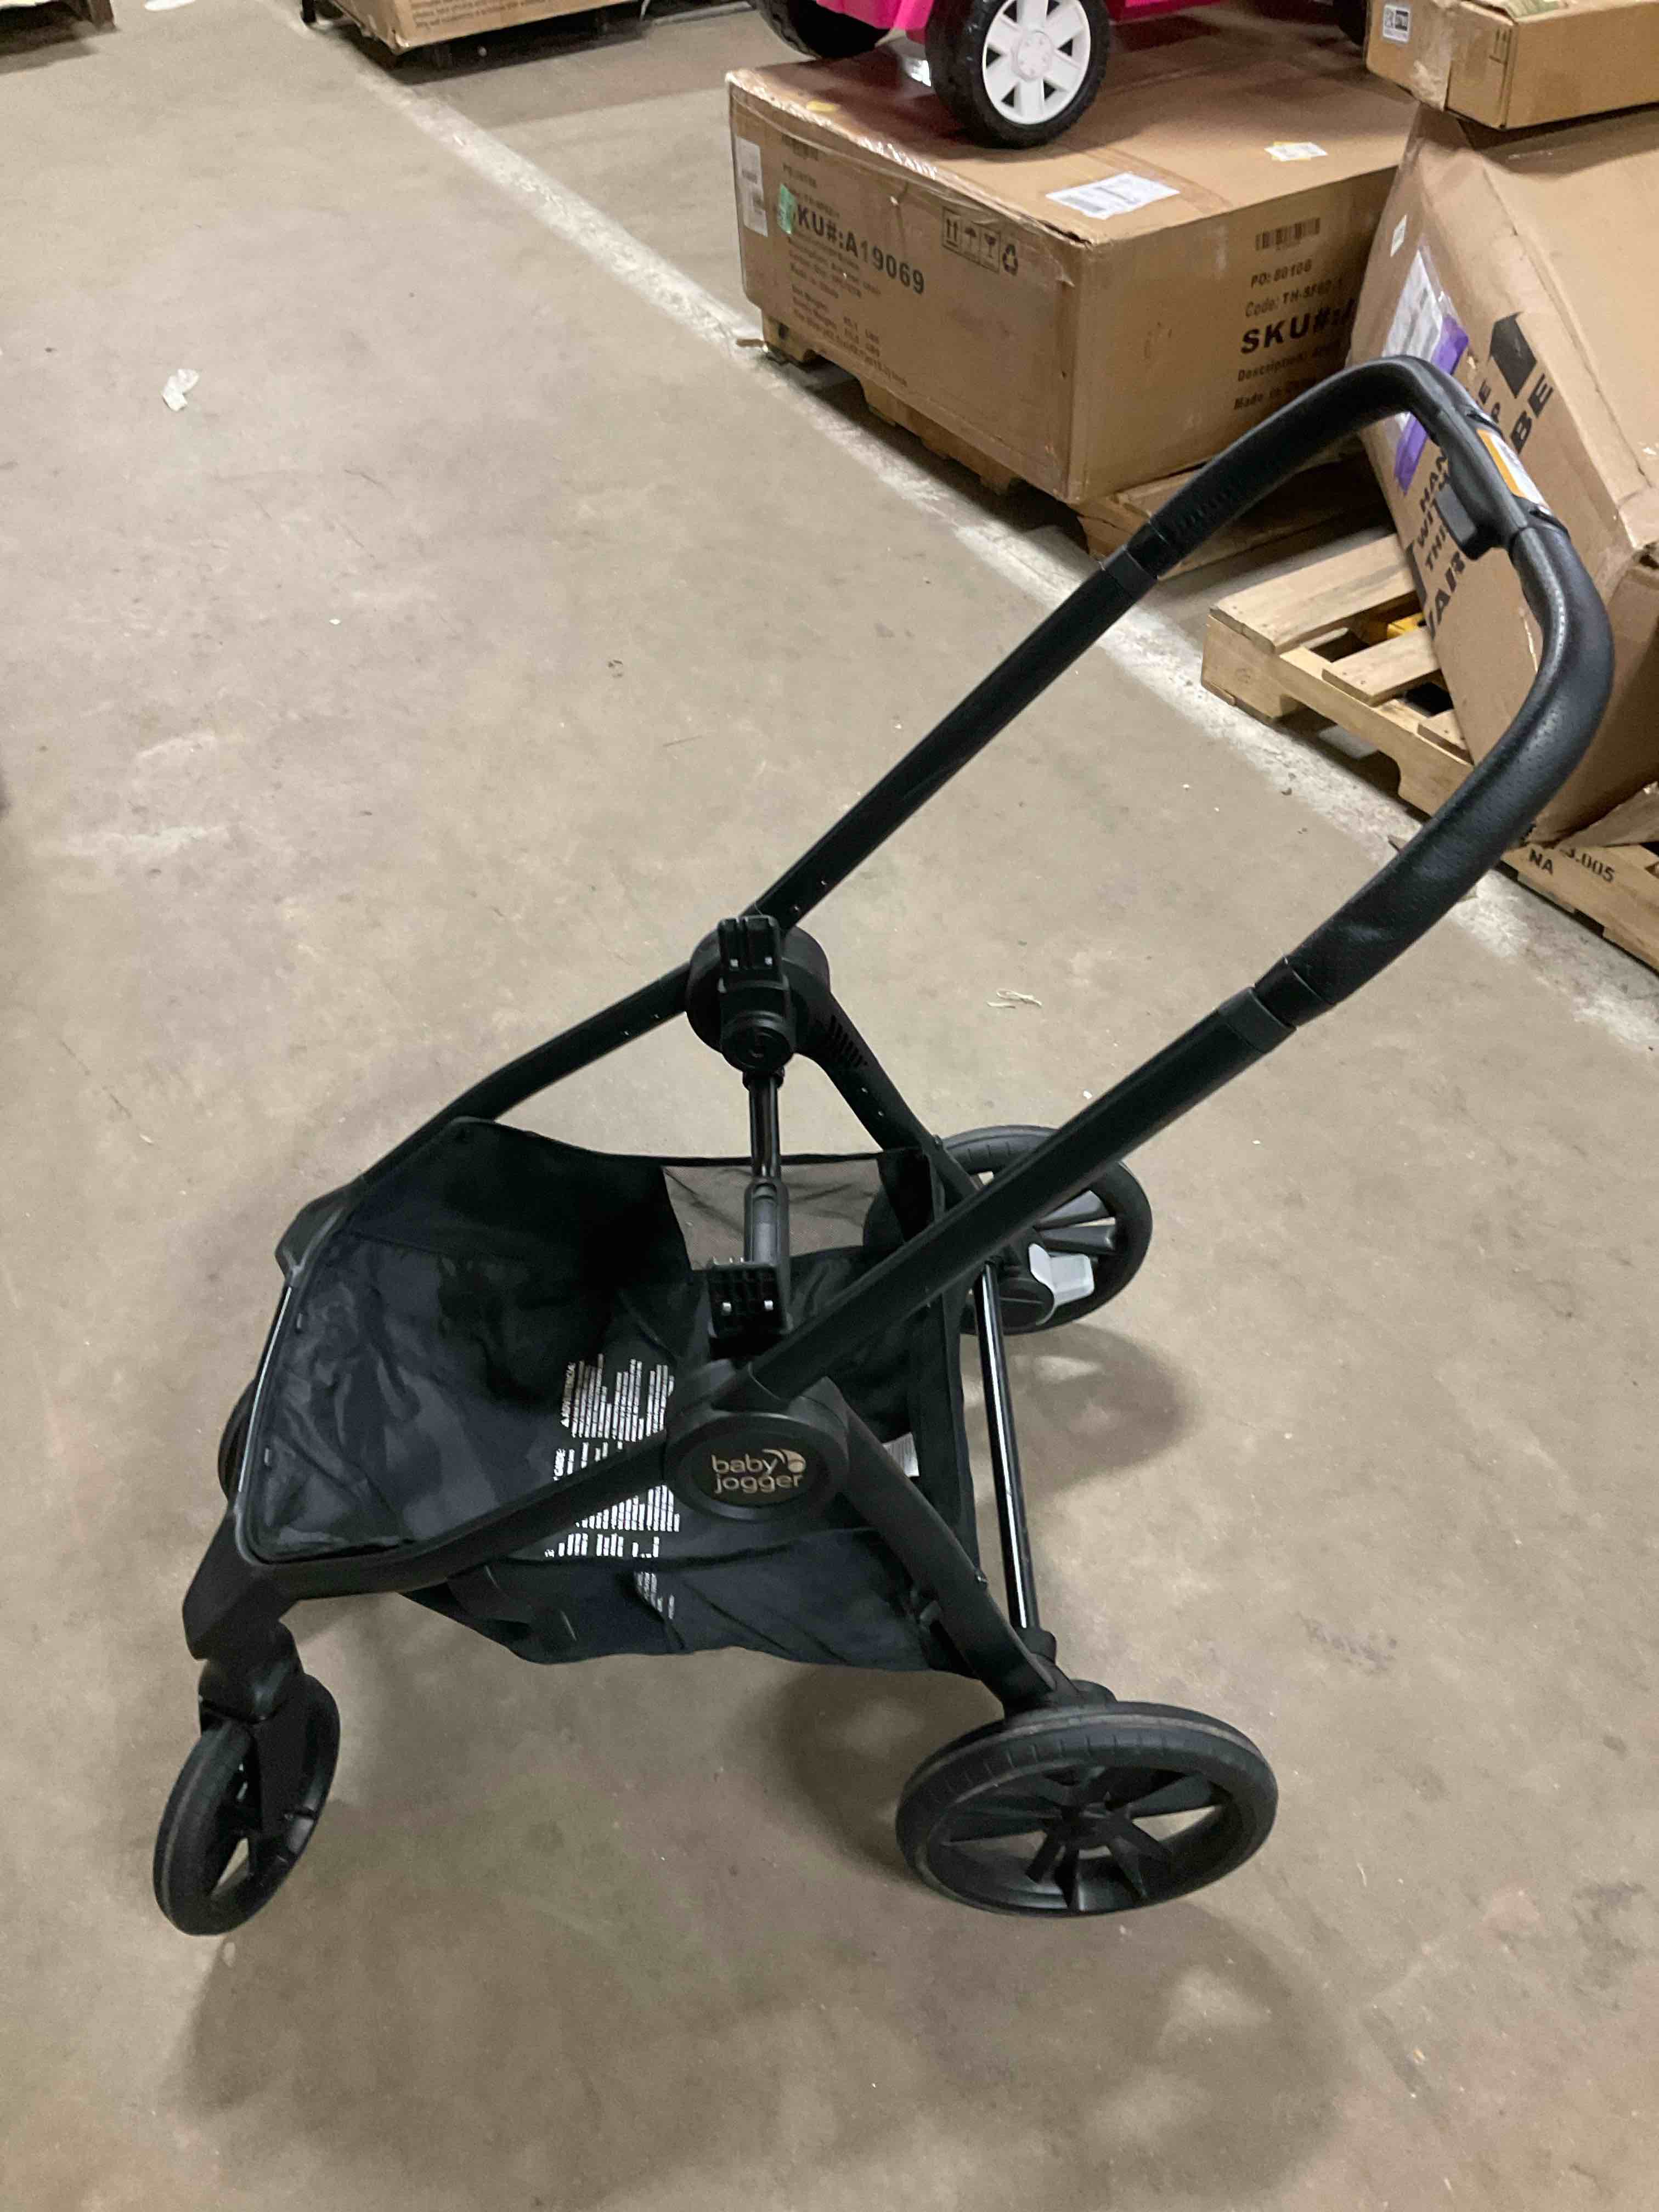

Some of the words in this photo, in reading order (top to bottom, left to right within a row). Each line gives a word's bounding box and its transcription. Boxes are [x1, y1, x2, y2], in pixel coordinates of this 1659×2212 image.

[793, 204, 925, 295] KU#:A19069
[1529, 848, 1554, 876] NA
[711, 1453, 778, 1476] baby
[714, 1472, 804, 1494] jogger
